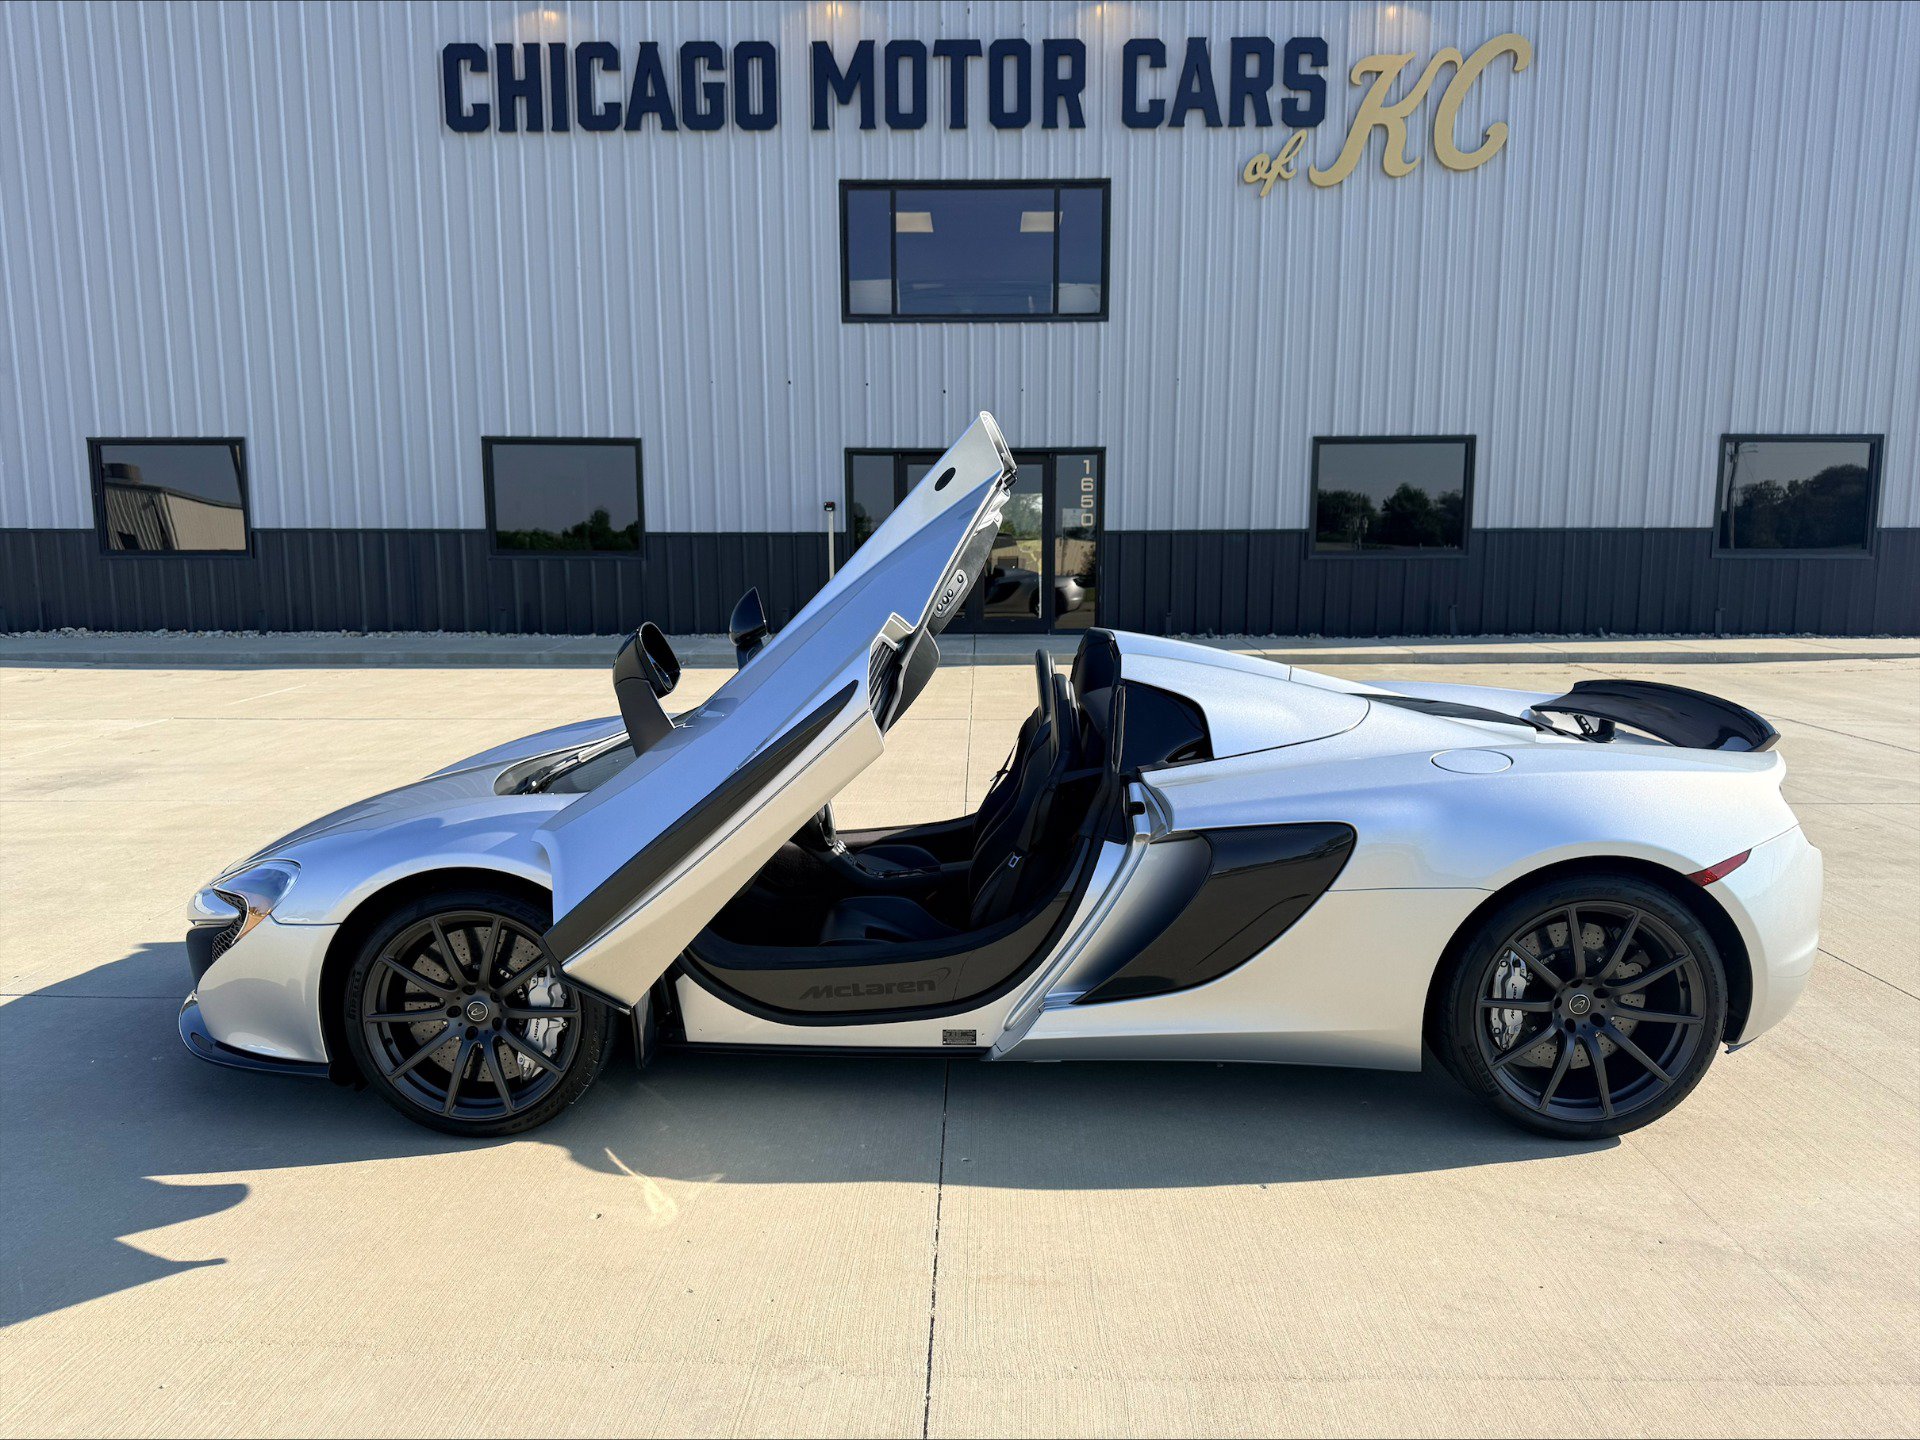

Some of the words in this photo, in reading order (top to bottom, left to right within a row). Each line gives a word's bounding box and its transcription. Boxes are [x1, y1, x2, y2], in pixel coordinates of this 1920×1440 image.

[443, 42, 777, 133] CHICAGO
[810, 39, 1087, 131] MOTOR
[1122, 37, 1328, 129] CARS
[1244, 130, 1307, 197] of
[1309, 33, 1531, 187] KC
[1081, 459, 1094, 527] 1650
[801, 979, 936, 1000] McLaren
